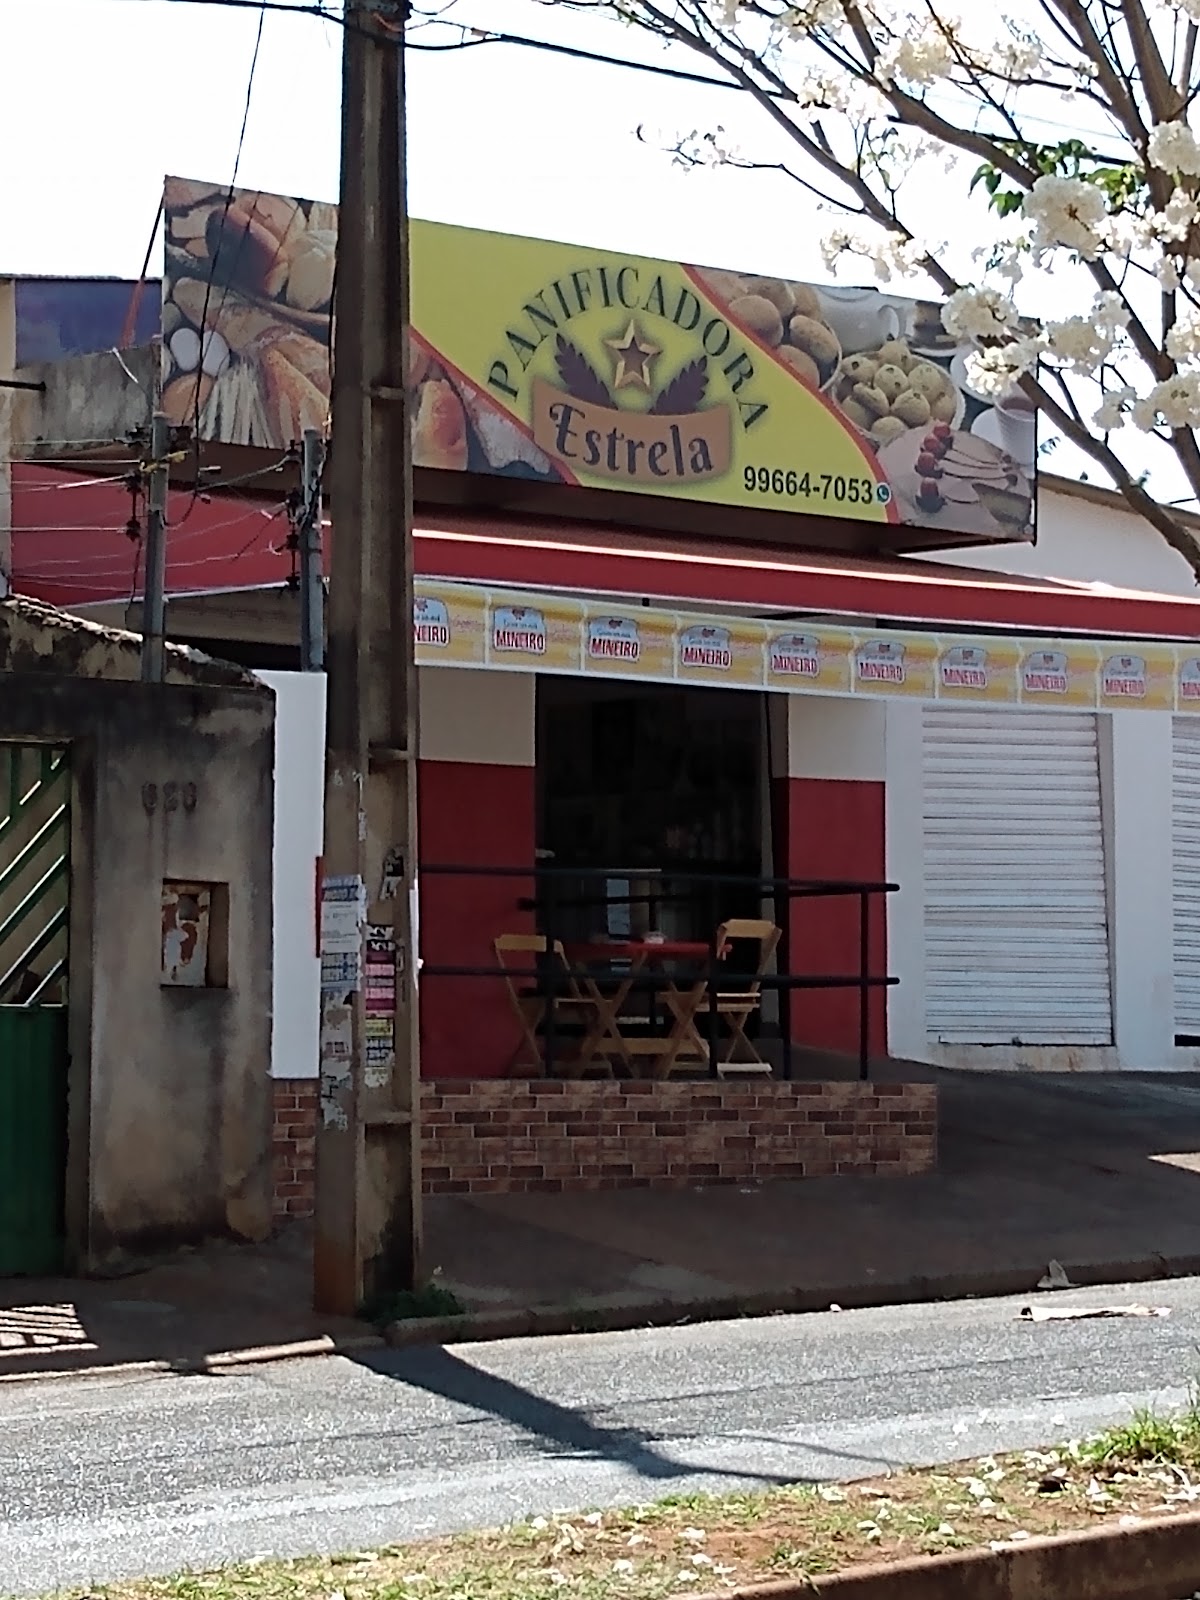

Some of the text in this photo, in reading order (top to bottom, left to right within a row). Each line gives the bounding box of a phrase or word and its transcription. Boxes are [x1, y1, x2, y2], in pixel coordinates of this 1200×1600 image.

[487, 265, 769, 430] PANIFICADORA
[549, 403, 715, 477] Estrela
[744, 465, 873, 505] 99664-7053
[414, 623, 448, 644] NEIRO
[495, 629, 545, 650] MINEIRO
[591, 637, 639, 659] MINEIRO
[683, 646, 731, 666] MINEIRO
[773, 654, 818, 673] MINEIRO
[860, 661, 903, 681] MINEIRO
